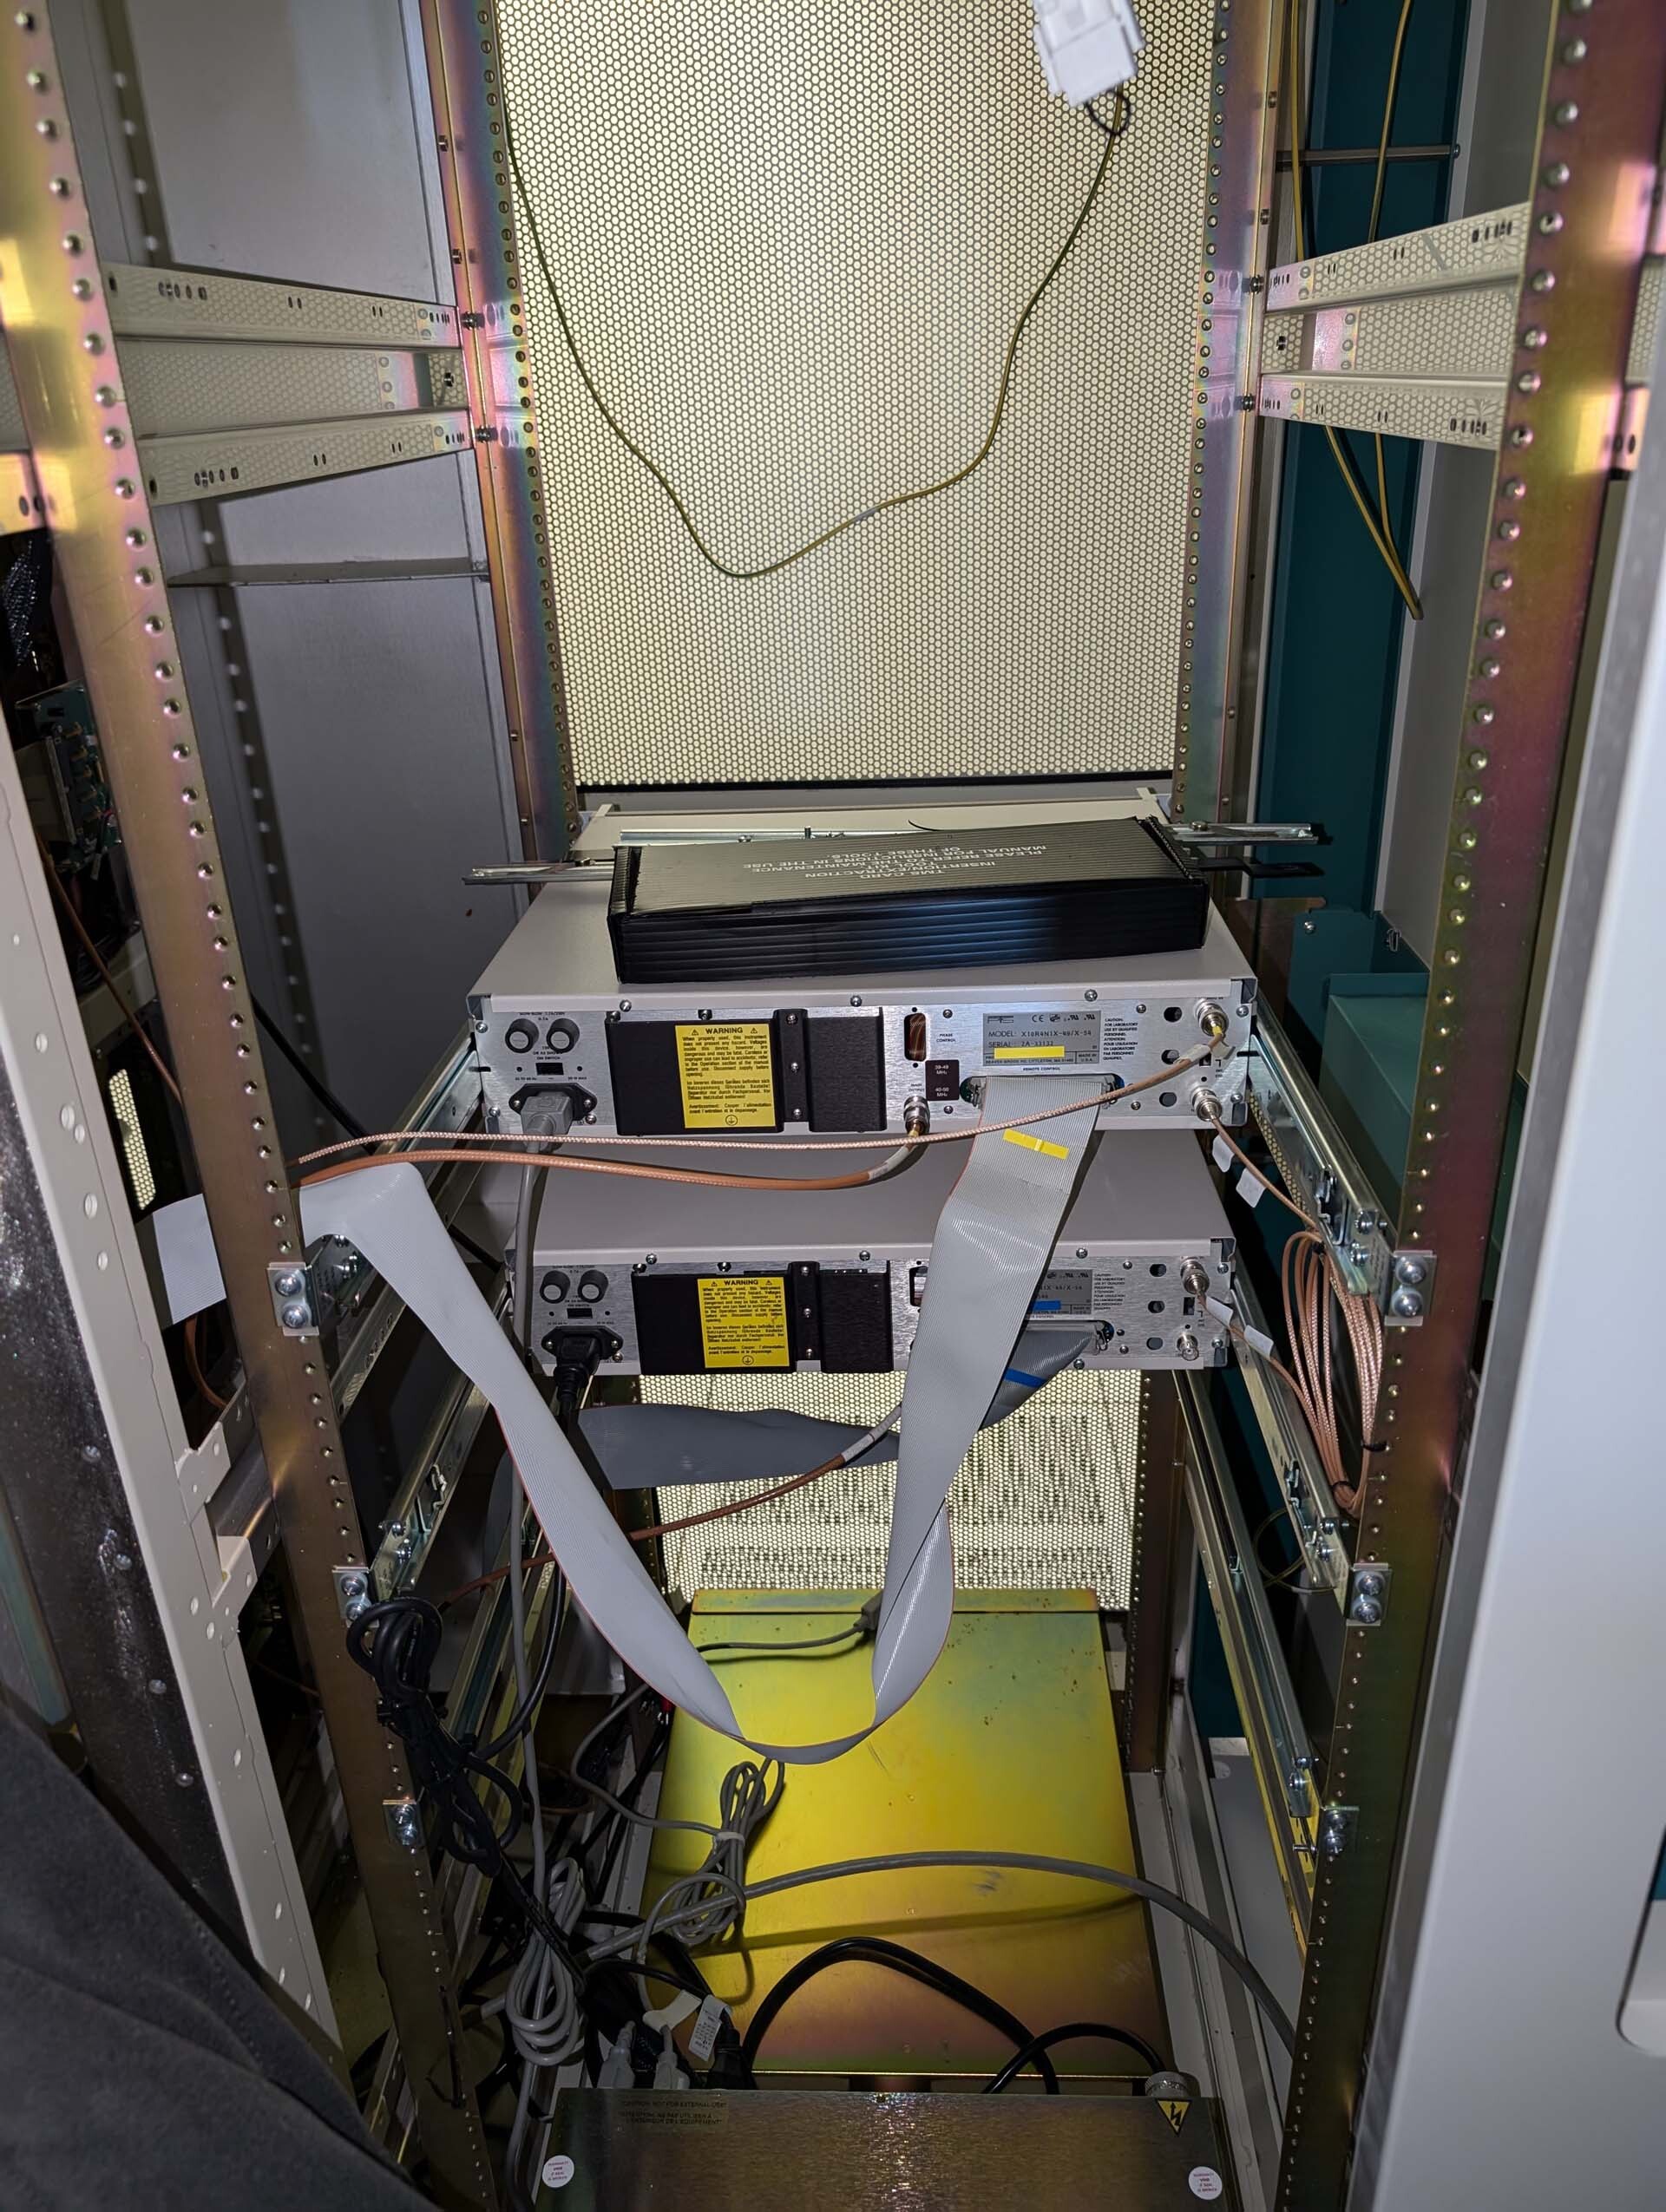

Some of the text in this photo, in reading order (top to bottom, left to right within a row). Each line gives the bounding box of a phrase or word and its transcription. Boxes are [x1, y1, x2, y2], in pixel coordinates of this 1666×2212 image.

[979, 845, 1047, 854] MANUAL
[752, 861, 866, 873] MAINTENANCE
[805, 861, 995, 878] INSERTION/EXTRACTION
